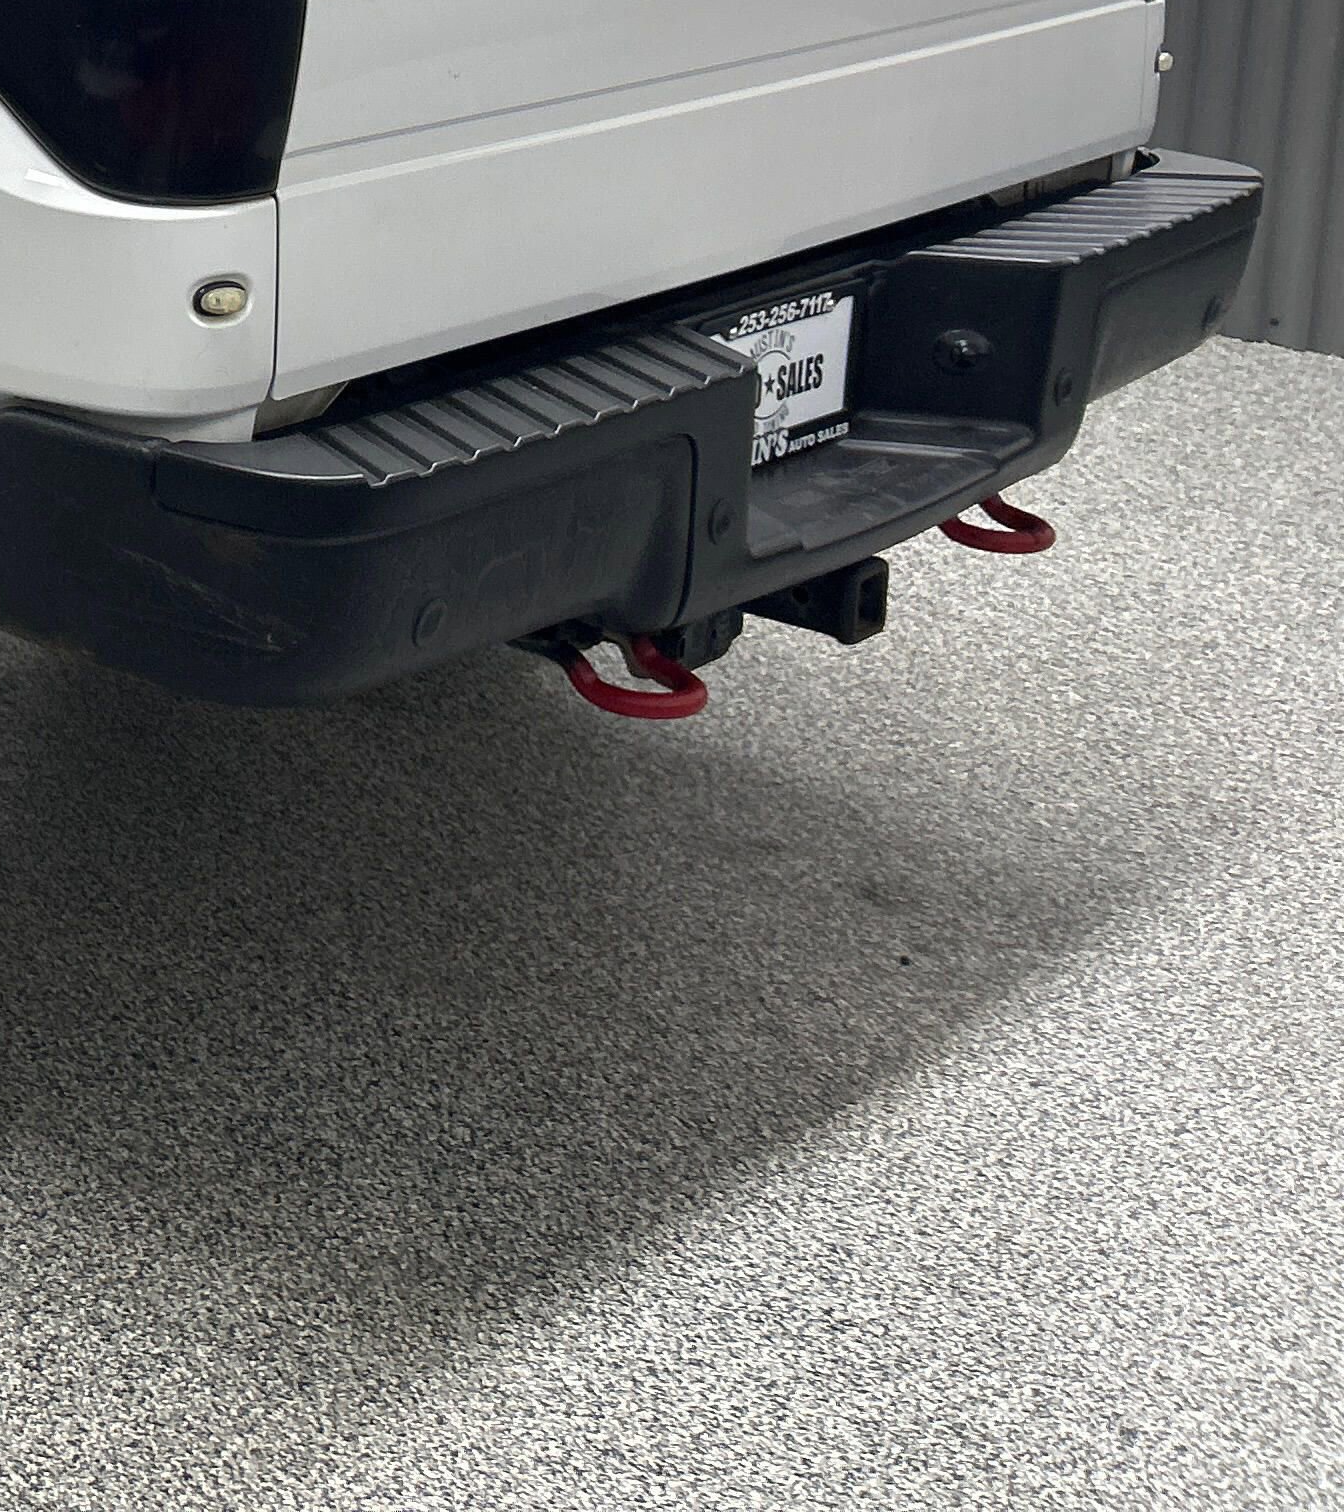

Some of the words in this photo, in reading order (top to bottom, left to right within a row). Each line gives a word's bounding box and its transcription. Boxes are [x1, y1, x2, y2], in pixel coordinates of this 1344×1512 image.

[737, 291, 834, 335] 253-256-7117
[776, 353, 824, 401] SALES
[788, 433, 816, 454] AUTO
[817, 422, 850, 443] SALES
